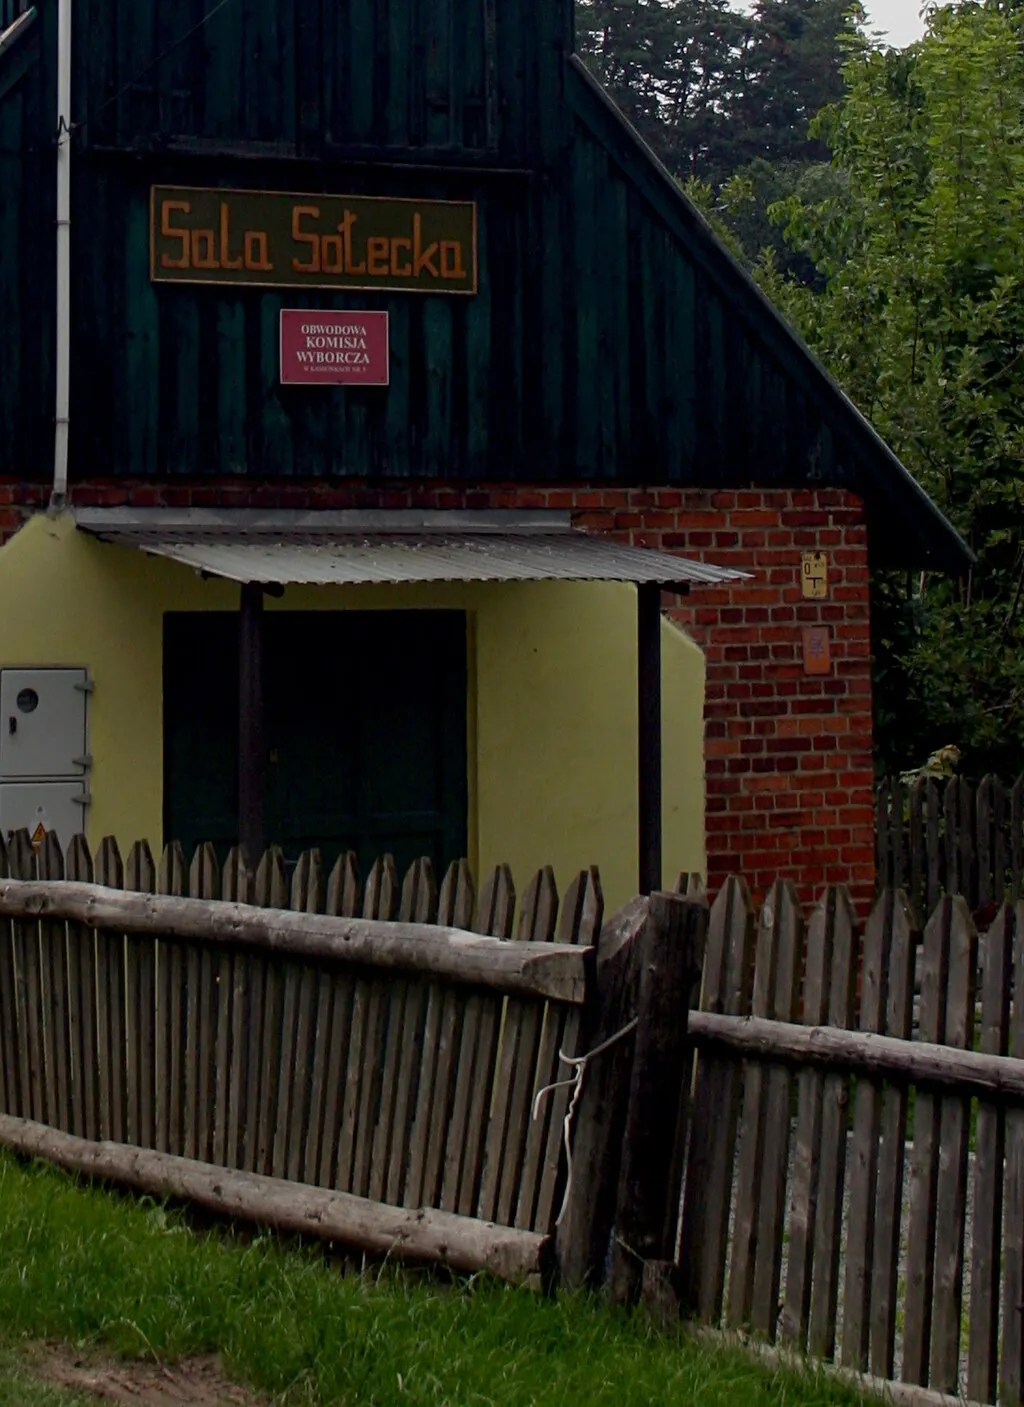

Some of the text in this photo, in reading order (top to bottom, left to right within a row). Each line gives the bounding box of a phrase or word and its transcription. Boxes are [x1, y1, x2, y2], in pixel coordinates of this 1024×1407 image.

[161, 200, 467, 279] Sala Sołecka
[301, 324, 367, 335] OBWODOWA
[306, 336, 366, 349] KOMISJA
[296, 351, 370, 364] WYBORCZA
